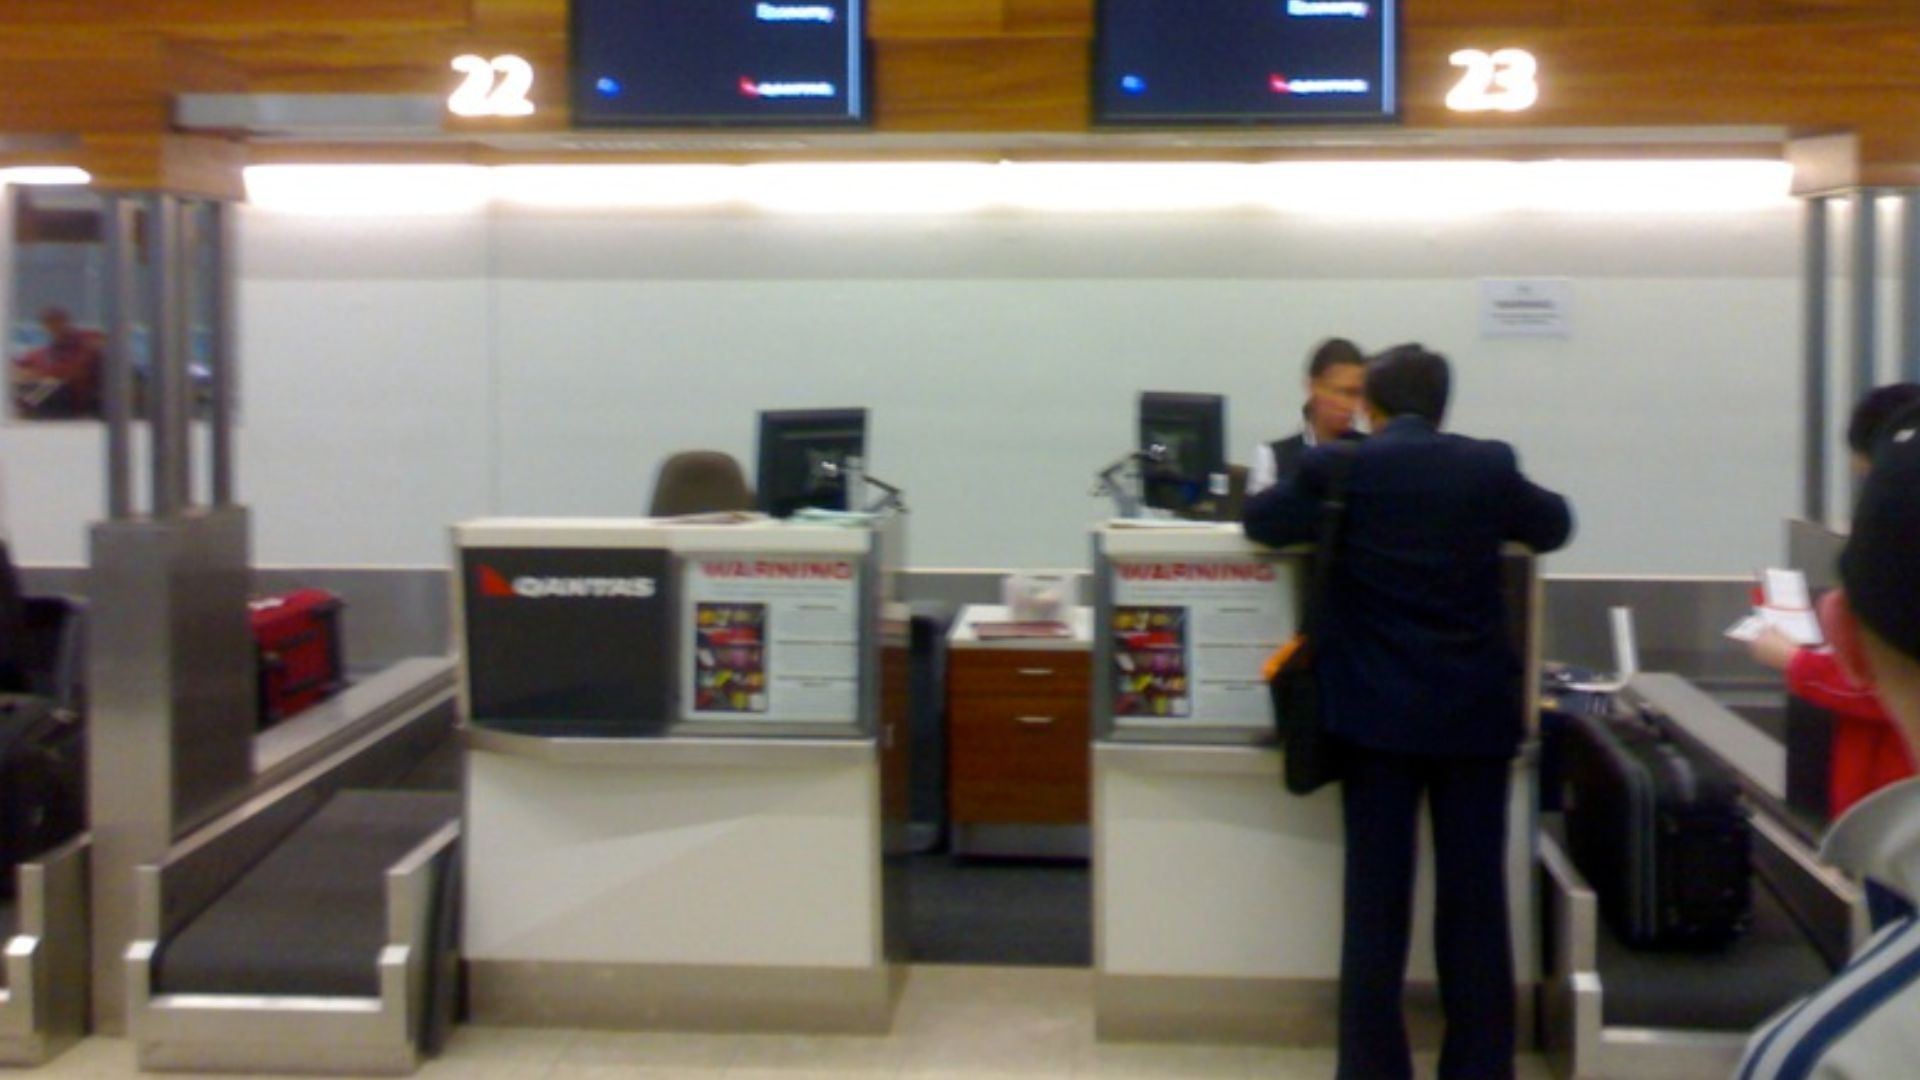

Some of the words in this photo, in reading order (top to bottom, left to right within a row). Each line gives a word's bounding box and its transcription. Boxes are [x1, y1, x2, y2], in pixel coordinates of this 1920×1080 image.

[447, 54, 536, 116] 22
[1445, 48, 1538, 111] 23
[512, 576, 656, 598] QANTAS
